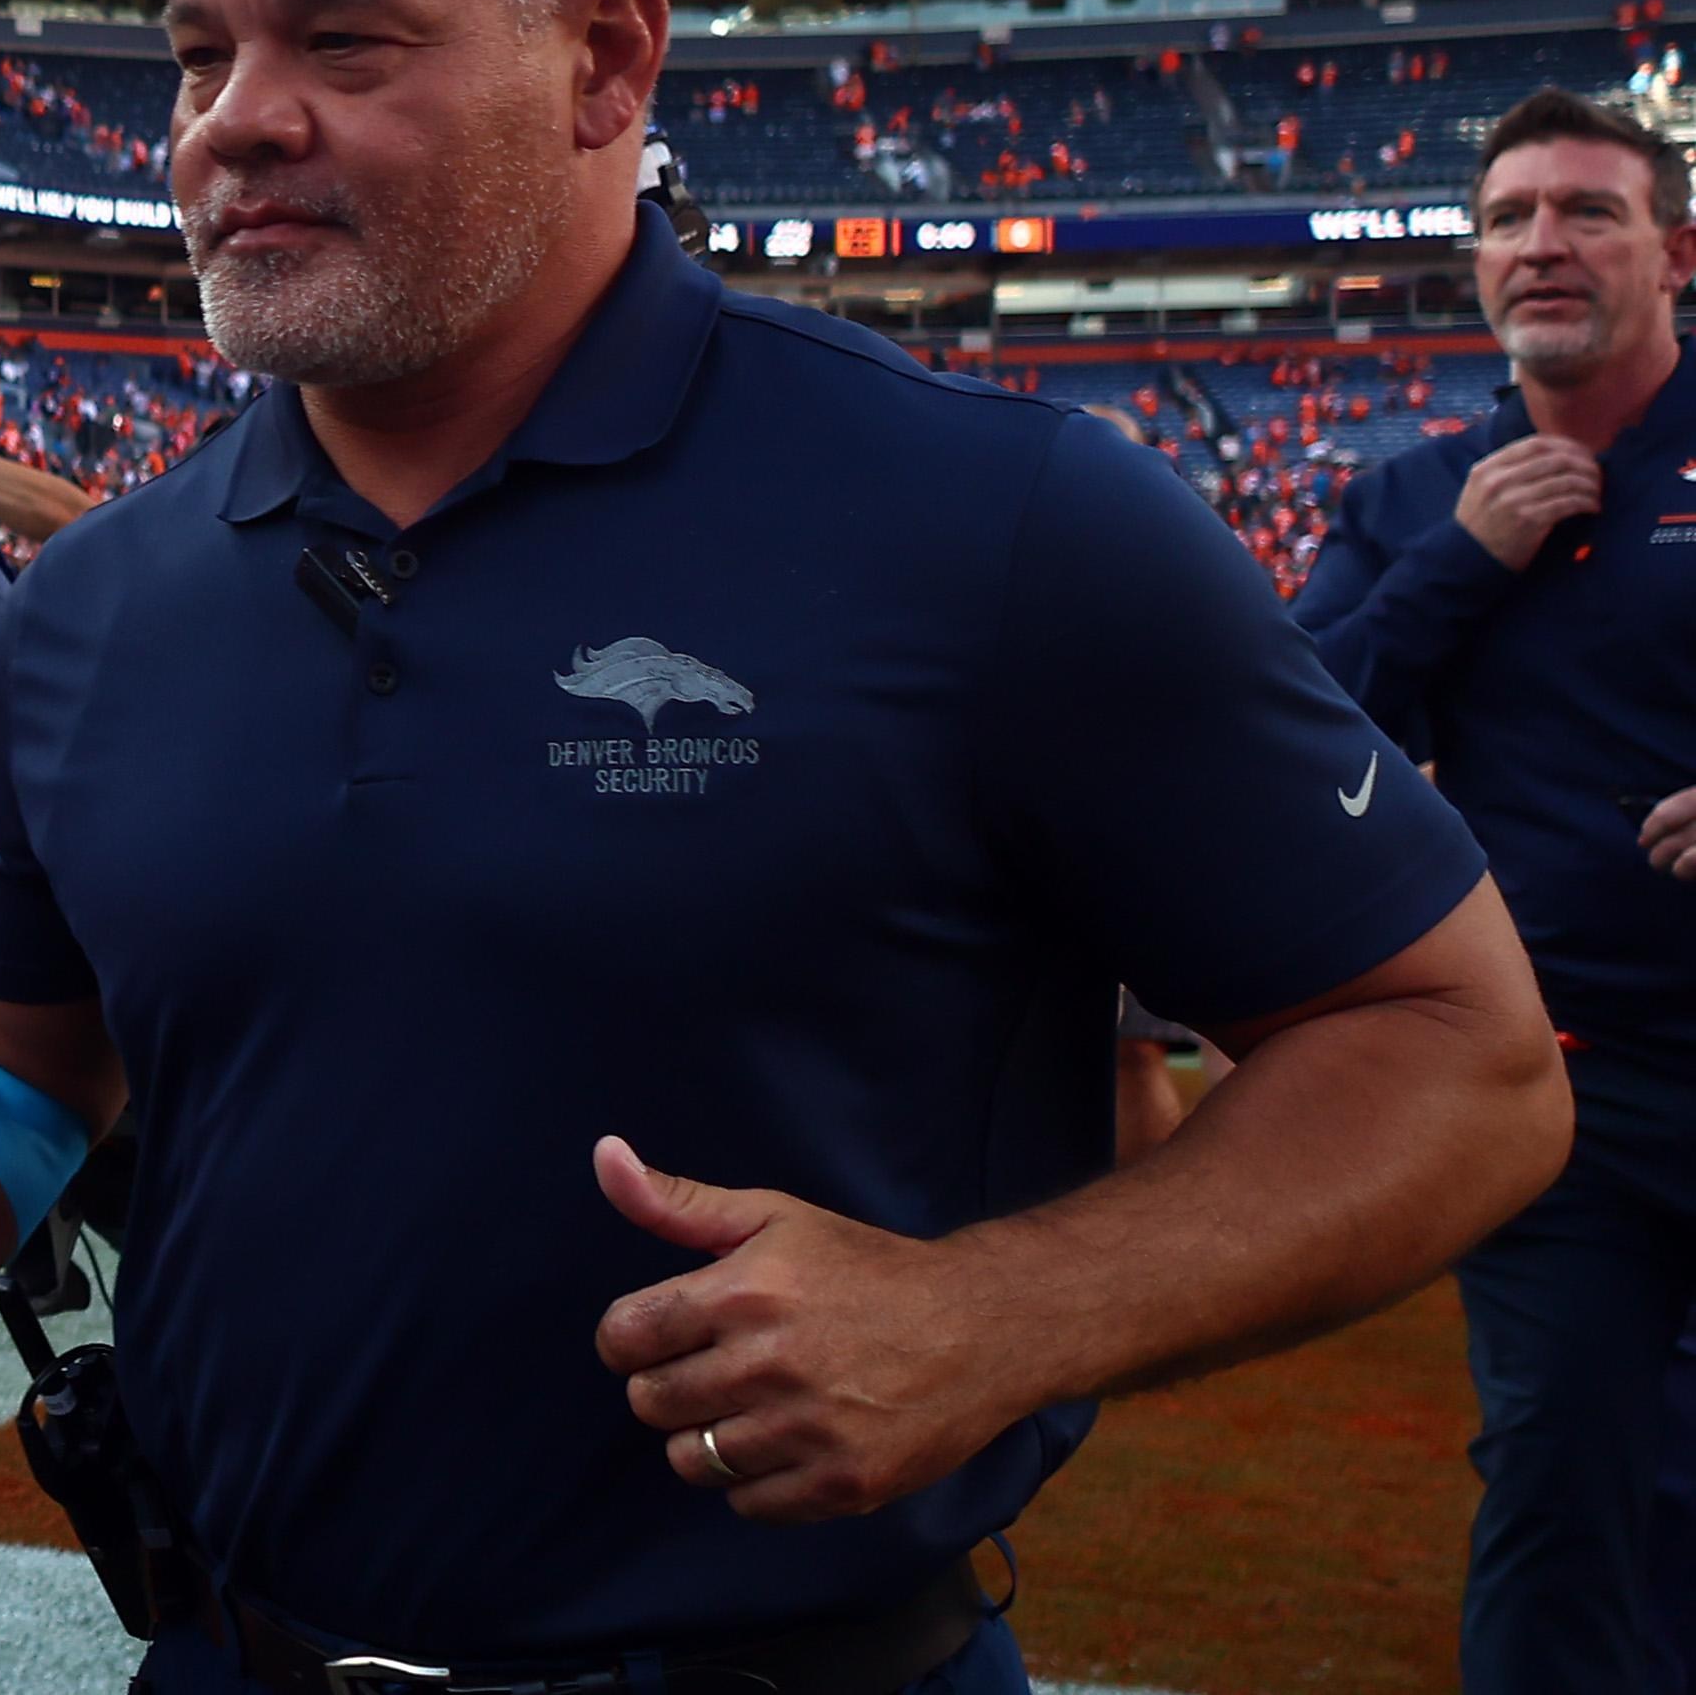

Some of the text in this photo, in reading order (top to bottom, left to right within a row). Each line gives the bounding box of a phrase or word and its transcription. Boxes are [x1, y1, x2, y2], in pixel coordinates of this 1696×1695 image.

[37, 189, 75, 220] HELP
[75, 194, 114, 224] YOU
[115, 197, 172, 229] BUILD
[1310, 206, 1475, 241] WE'LL HEL
[547, 738, 760, 767] DENVER BRONCOS
[595, 768, 708, 794] SECURITY
